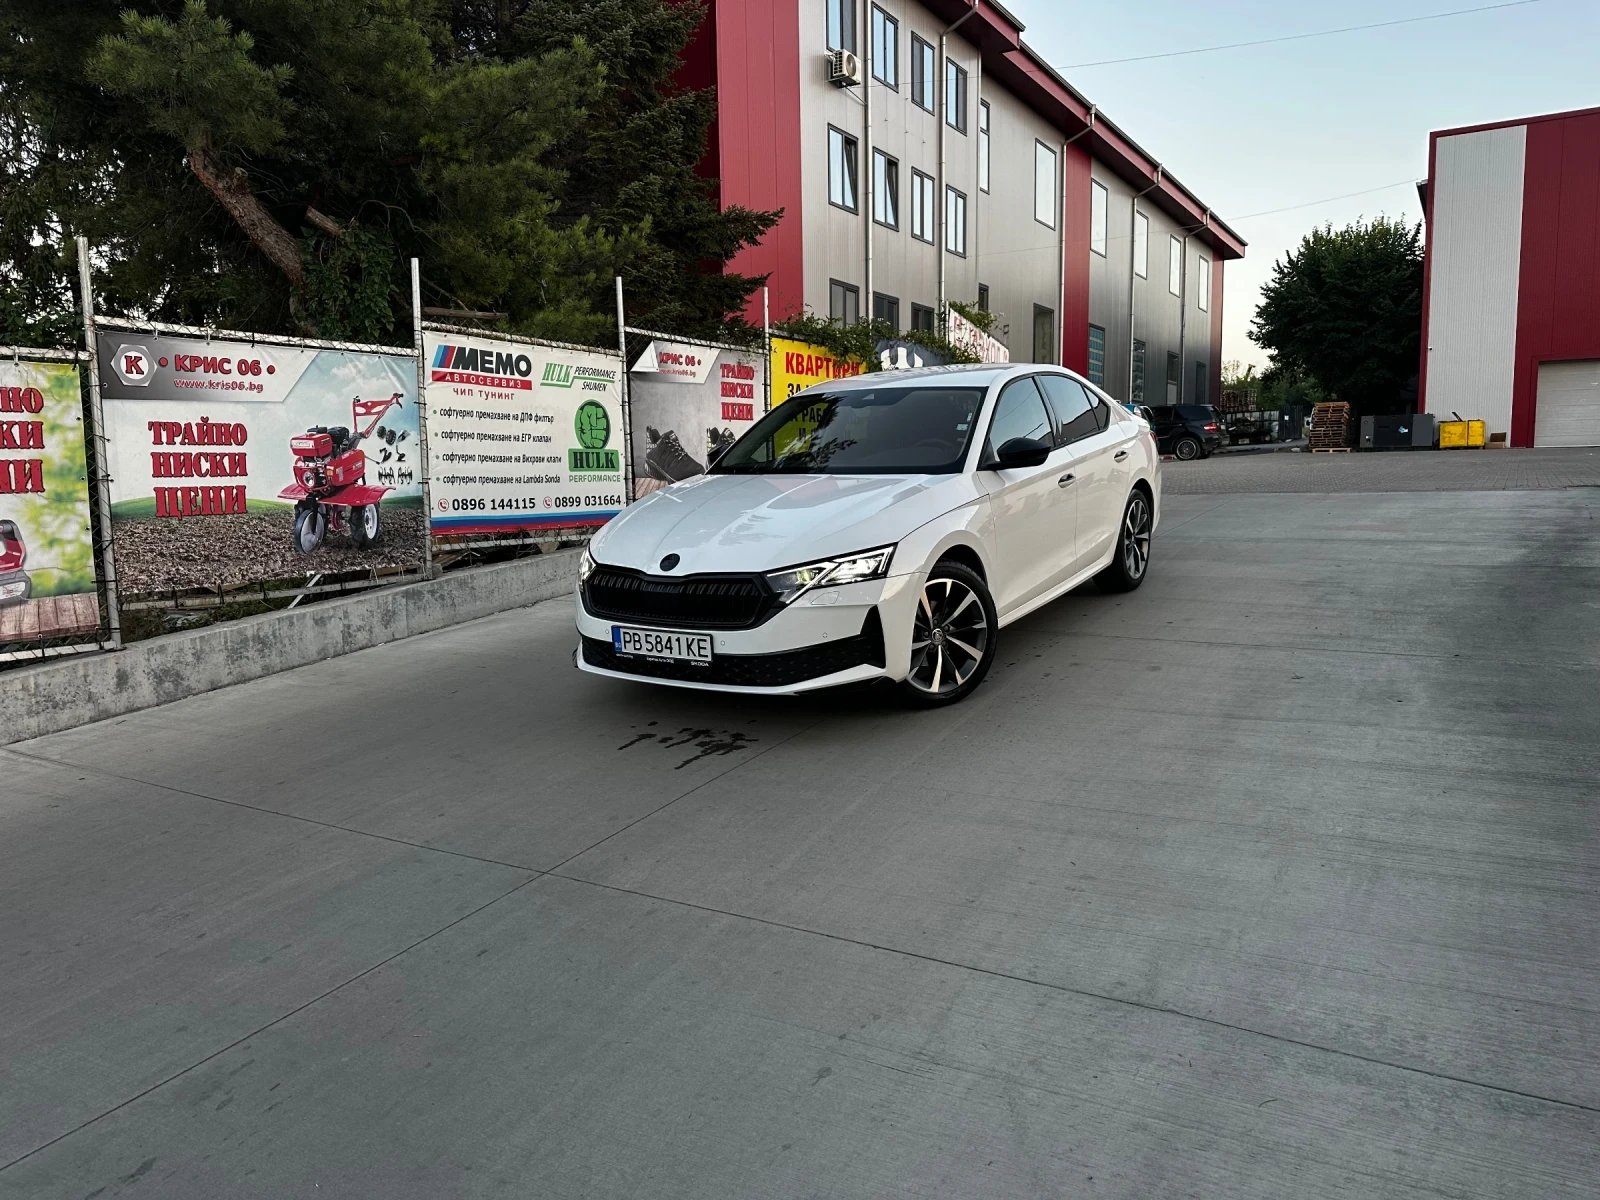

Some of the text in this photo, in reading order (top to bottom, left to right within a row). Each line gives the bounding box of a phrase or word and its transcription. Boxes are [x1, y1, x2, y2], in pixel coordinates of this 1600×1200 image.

[175, 354, 262, 376] КРИС 06
[452, 346, 532, 378] MEMO
[659, 352, 696, 367] КРИС 06
[445, 373, 522, 389] АВТОСЕРВИЗ
[541, 363, 617, 383] HULK PERFORMANCE
[174, 378, 264, 394] www.kris06.bg
[582, 381, 608, 392] SHUMEN
[720, 381, 754, 399] НИСКИ
[440, 407, 474, 419] софтуерно
[475, 410, 511, 421] премахване
[512, 413, 519, 421] на
[520, 412, 533, 423] ДПФ
[720, 402, 754, 422] ЦЕНИ
[148, 416, 248, 446] ТРАЙНО
[441, 429, 475, 441] софтуерно
[476, 432, 512, 442] премахване
[521, 433, 532, 442] ЕГР
[150, 452, 248, 478] НИСКИ
[442, 452, 476, 464] софтуерно
[477, 454, 513, 464] премахване
[573, 451, 615, 469] HULK
[443, 474, 477, 486] софтуерно
[478, 476, 514, 486] премахване
[523, 474, 544, 484] Lambda
[544, 474, 561, 484] Sonda
[569, 475, 621, 483] PERFORMANCE
[153, 485, 248, 520] ЦЕНИ
[452, 498, 536, 511] 0896 144115
[554, 495, 621, 508] 0899 031664
